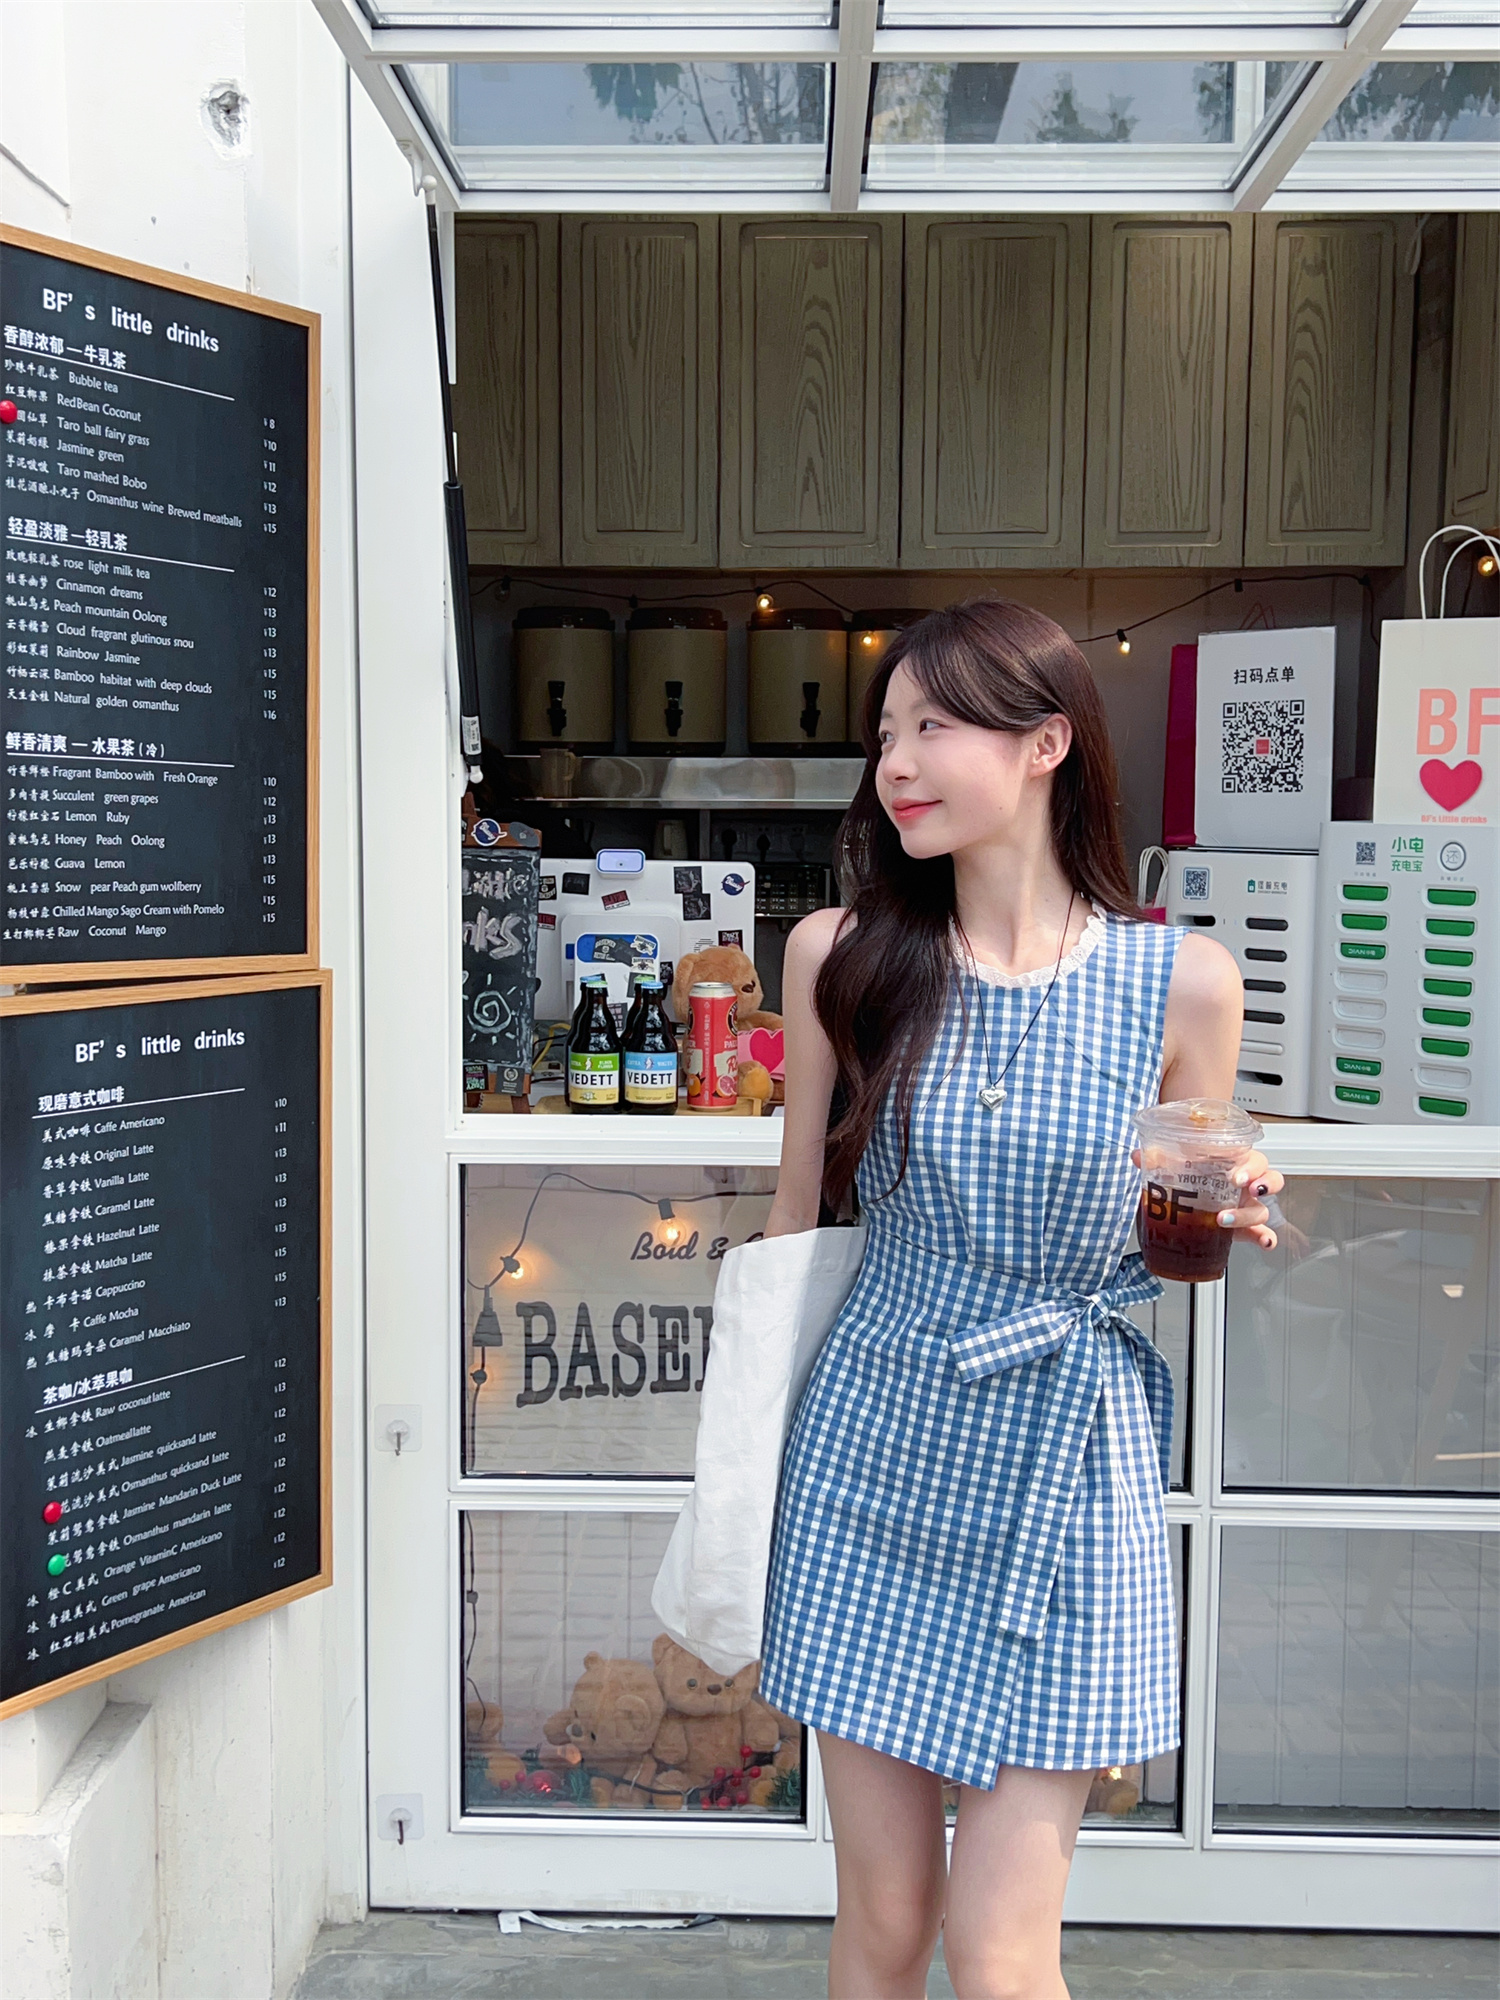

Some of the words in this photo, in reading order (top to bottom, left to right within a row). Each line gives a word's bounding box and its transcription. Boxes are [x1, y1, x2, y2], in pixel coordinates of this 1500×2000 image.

[112, 306, 152, 335] little
[166, 322, 219, 352] drinks
[69, 372, 102, 389] Bubble
[104, 381, 118, 393] tea
[102, 404, 141, 422] Coconut
[57, 416, 80, 432] Taro
[84, 422, 101, 436] ball
[105, 426, 126, 443] fairy
[128, 434, 150, 446] grass
[57, 439, 94, 456] Jasmine
[98, 450, 124, 462] green
[57, 463, 80, 478] Taro
[84, 471, 119, 484] mashed
[123, 475, 147, 490] Bobo
[87, 490, 138, 509] Osmanthus
[142, 501, 164, 514] wine
[168, 504, 200, 520] Brewed
[204, 513, 242, 527] meatballs
[64, 559, 84, 570] rose
[88, 560, 109, 575] light
[113, 565, 133, 576] milk
[136, 568, 150, 579] tea
[56, 578, 105, 595] Cinnamon
[110, 586, 143, 600] dreams
[54, 599, 81, 613] Peach
[85, 606, 129, 619] mountain
[132, 609, 167, 626] Oolong
[56, 622, 85, 636] Cloud
[91, 626, 127, 642] fragrant
[130, 632, 171, 646] glutinous
[57, 646, 99, 660] Rainbow
[104, 651, 140, 664] Jasmine
[54, 668, 94, 683] Bamboo
[100, 673, 132, 686] habitat
[136, 677, 156, 688] with
[160, 679, 182, 693] deep
[185, 681, 212, 694] clouds
[1233, 666, 1296, 685] 扫码点单
[54, 691, 90, 704] Natural
[96, 695, 128, 708] golden
[132, 700, 179, 712] osmanthus
[1416, 688, 1500, 755] BF
[53, 766, 91, 780] Fragrant
[96, 768, 133, 780] Bamboo
[134, 770, 154, 781] with
[164, 772, 186, 782] Fresh
[187, 772, 218, 786] Orange
[52, 789, 94, 801] Succulent
[104, 794, 129, 804] green
[130, 795, 158, 806] grapes
[66, 810, 97, 822] Lemon
[106, 812, 130, 825] Ruby
[1461, 816, 1487, 824] drinks
[55, 834, 87, 847] Honey
[96, 834, 122, 845] Peach
[131, 835, 165, 848] Oolong
[1391, 836, 1424, 853] 小电
[55, 858, 85, 868] Guava
[94, 858, 125, 868] Lemon
[1391, 860, 1423, 872] 充电宝
[1445, 850, 1459, 864] 还
[55, 881, 81, 892] Snow
[90, 884, 111, 894] pear
[113, 881, 138, 892] Peach
[140, 884, 158, 894] gum
[160, 881, 201, 893] wolfberry
[52, 906, 85, 917] Chilled
[87, 906, 119, 918] Mango
[120, 905, 141, 918] Sago
[143, 904, 171, 915] Cream
[172, 904, 191, 914] with
[194, 904, 224, 914] Pomelo
[58, 926, 79, 937] Raw
[88, 926, 126, 936] Coconut
[136, 925, 166, 937] Mango
[142, 1034, 181, 1055] little
[194, 1028, 245, 1049] drinks
[571, 1072, 613, 1086] VEDETT
[627, 1071, 673, 1085] VEDETT
[38, 1086, 124, 1112] 现磨意式咖啡
[94, 1121, 117, 1134] Caffe
[119, 1117, 165, 1130] Americano
[94, 1146, 129, 1162] Original
[133, 1145, 154, 1155] Latte
[94, 1175, 124, 1188] Vanilla
[128, 1172, 149, 1183] Latte
[95, 1200, 130, 1216] Caramel
[134, 1198, 155, 1208] Latte
[1147, 1181, 1199, 1226] BF
[97, 1228, 135, 1242] Hazelnut
[139, 1224, 159, 1234] Latte
[95, 1256, 127, 1270] Matcha
[132, 1252, 152, 1263] Latte
[96, 1280, 145, 1297] Cappuccino
[84, 1314, 106, 1327] Caffe
[109, 1307, 138, 1321] Mocha
[110, 1331, 144, 1348] Caramel
[148, 1322, 190, 1338] Macchiato
[96, 1406, 115, 1418] Raw
[121, 1450, 154, 1466] Jasmine
[157, 1434, 196, 1456] quicksand
[199, 1432, 216, 1442] latte
[122, 1472, 167, 1492] Osmanthus
[170, 1456, 209, 1477] quicksand
[212, 1452, 229, 1463] latte
[123, 1502, 156, 1519] Jasmine
[159, 1487, 198, 1507] Mandarin
[201, 1479, 220, 1493] Duck
[223, 1474, 242, 1486] Latte
[123, 1524, 169, 1545] Osmanthus
[173, 1510, 210, 1529] mandarin
[214, 1503, 232, 1515] latte
[104, 1561, 136, 1578] Orange
[180, 1532, 222, 1552] Americano
[102, 1591, 128, 1606] Green
[132, 1579, 156, 1596] grape
[158, 1565, 201, 1586] Americano
[111, 1604, 165, 1630] Pomegranate
[168, 1590, 206, 1609] American
